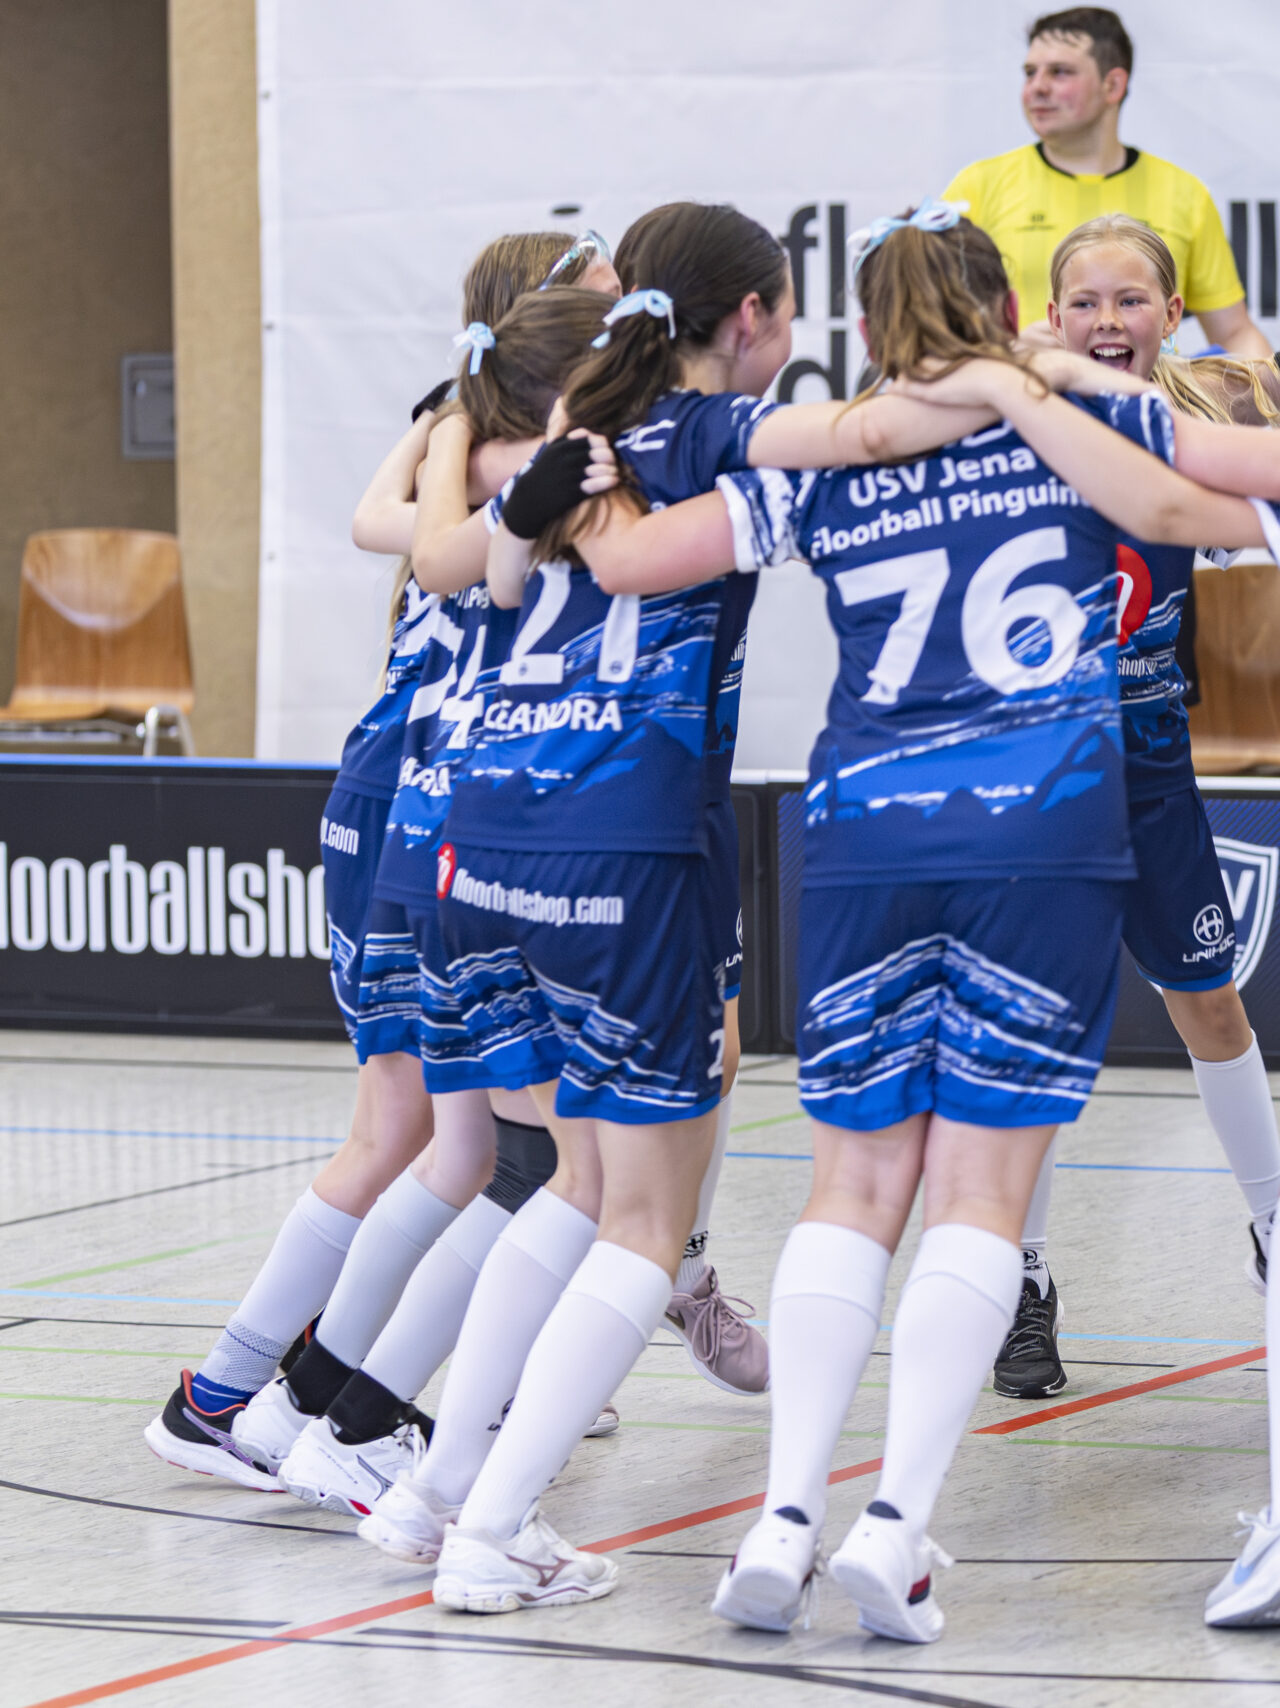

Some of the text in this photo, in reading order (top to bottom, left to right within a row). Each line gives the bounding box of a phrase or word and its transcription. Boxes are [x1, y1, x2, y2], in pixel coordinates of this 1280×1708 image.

[848, 447, 1037, 507] USV Jena
[834, 526, 1087, 704] 76
